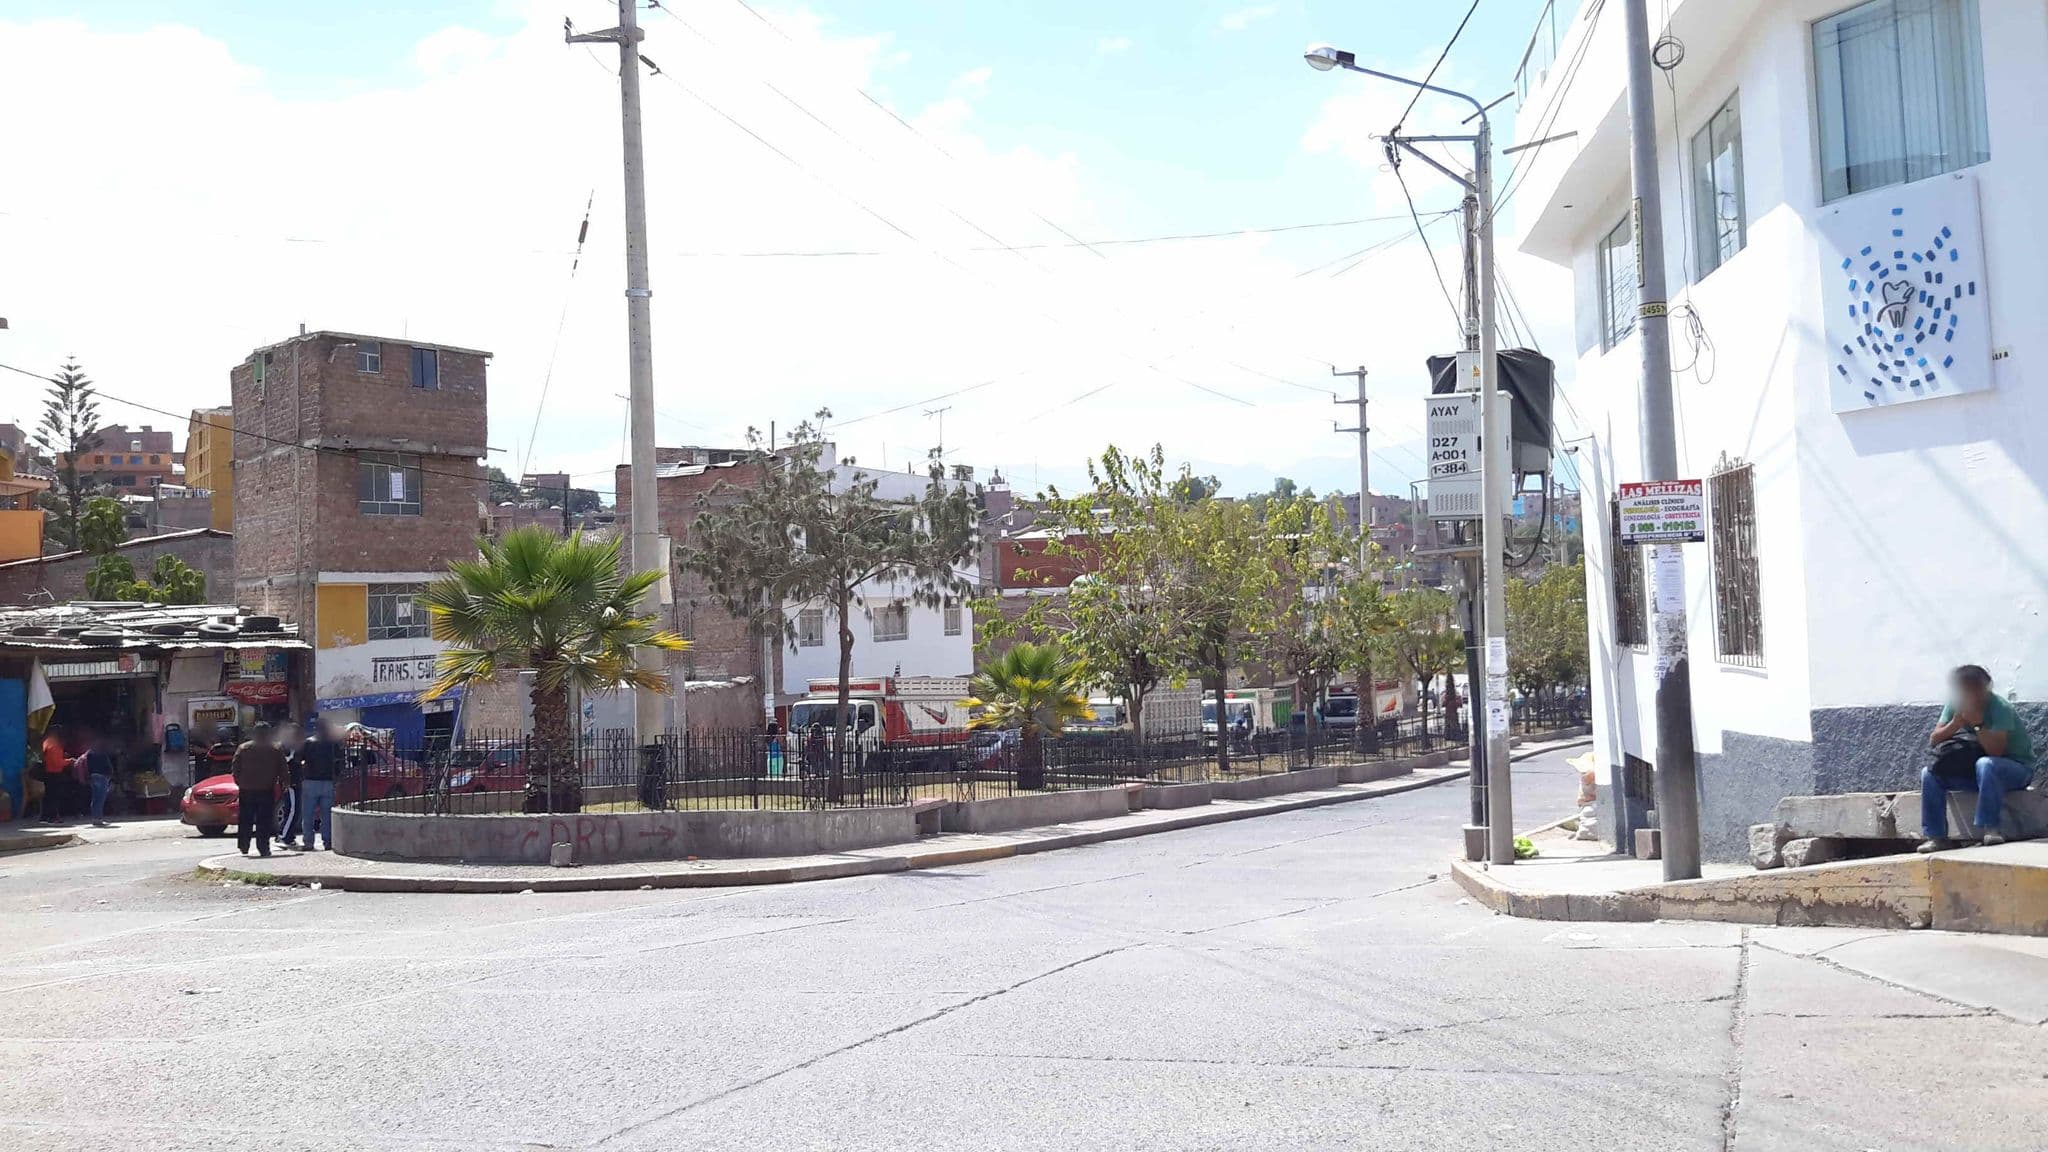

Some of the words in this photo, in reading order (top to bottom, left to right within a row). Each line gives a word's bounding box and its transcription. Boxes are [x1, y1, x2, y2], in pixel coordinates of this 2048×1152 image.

[1430, 405, 1460, 417] AYAY
[1432, 436, 1459, 448] D27
[1431, 449, 1467, 461] A-001
[1621, 487, 1642, 499] LAS
[1645, 484, 1701, 496] MELLIZAS
[372, 657, 413, 683] TRANS.
